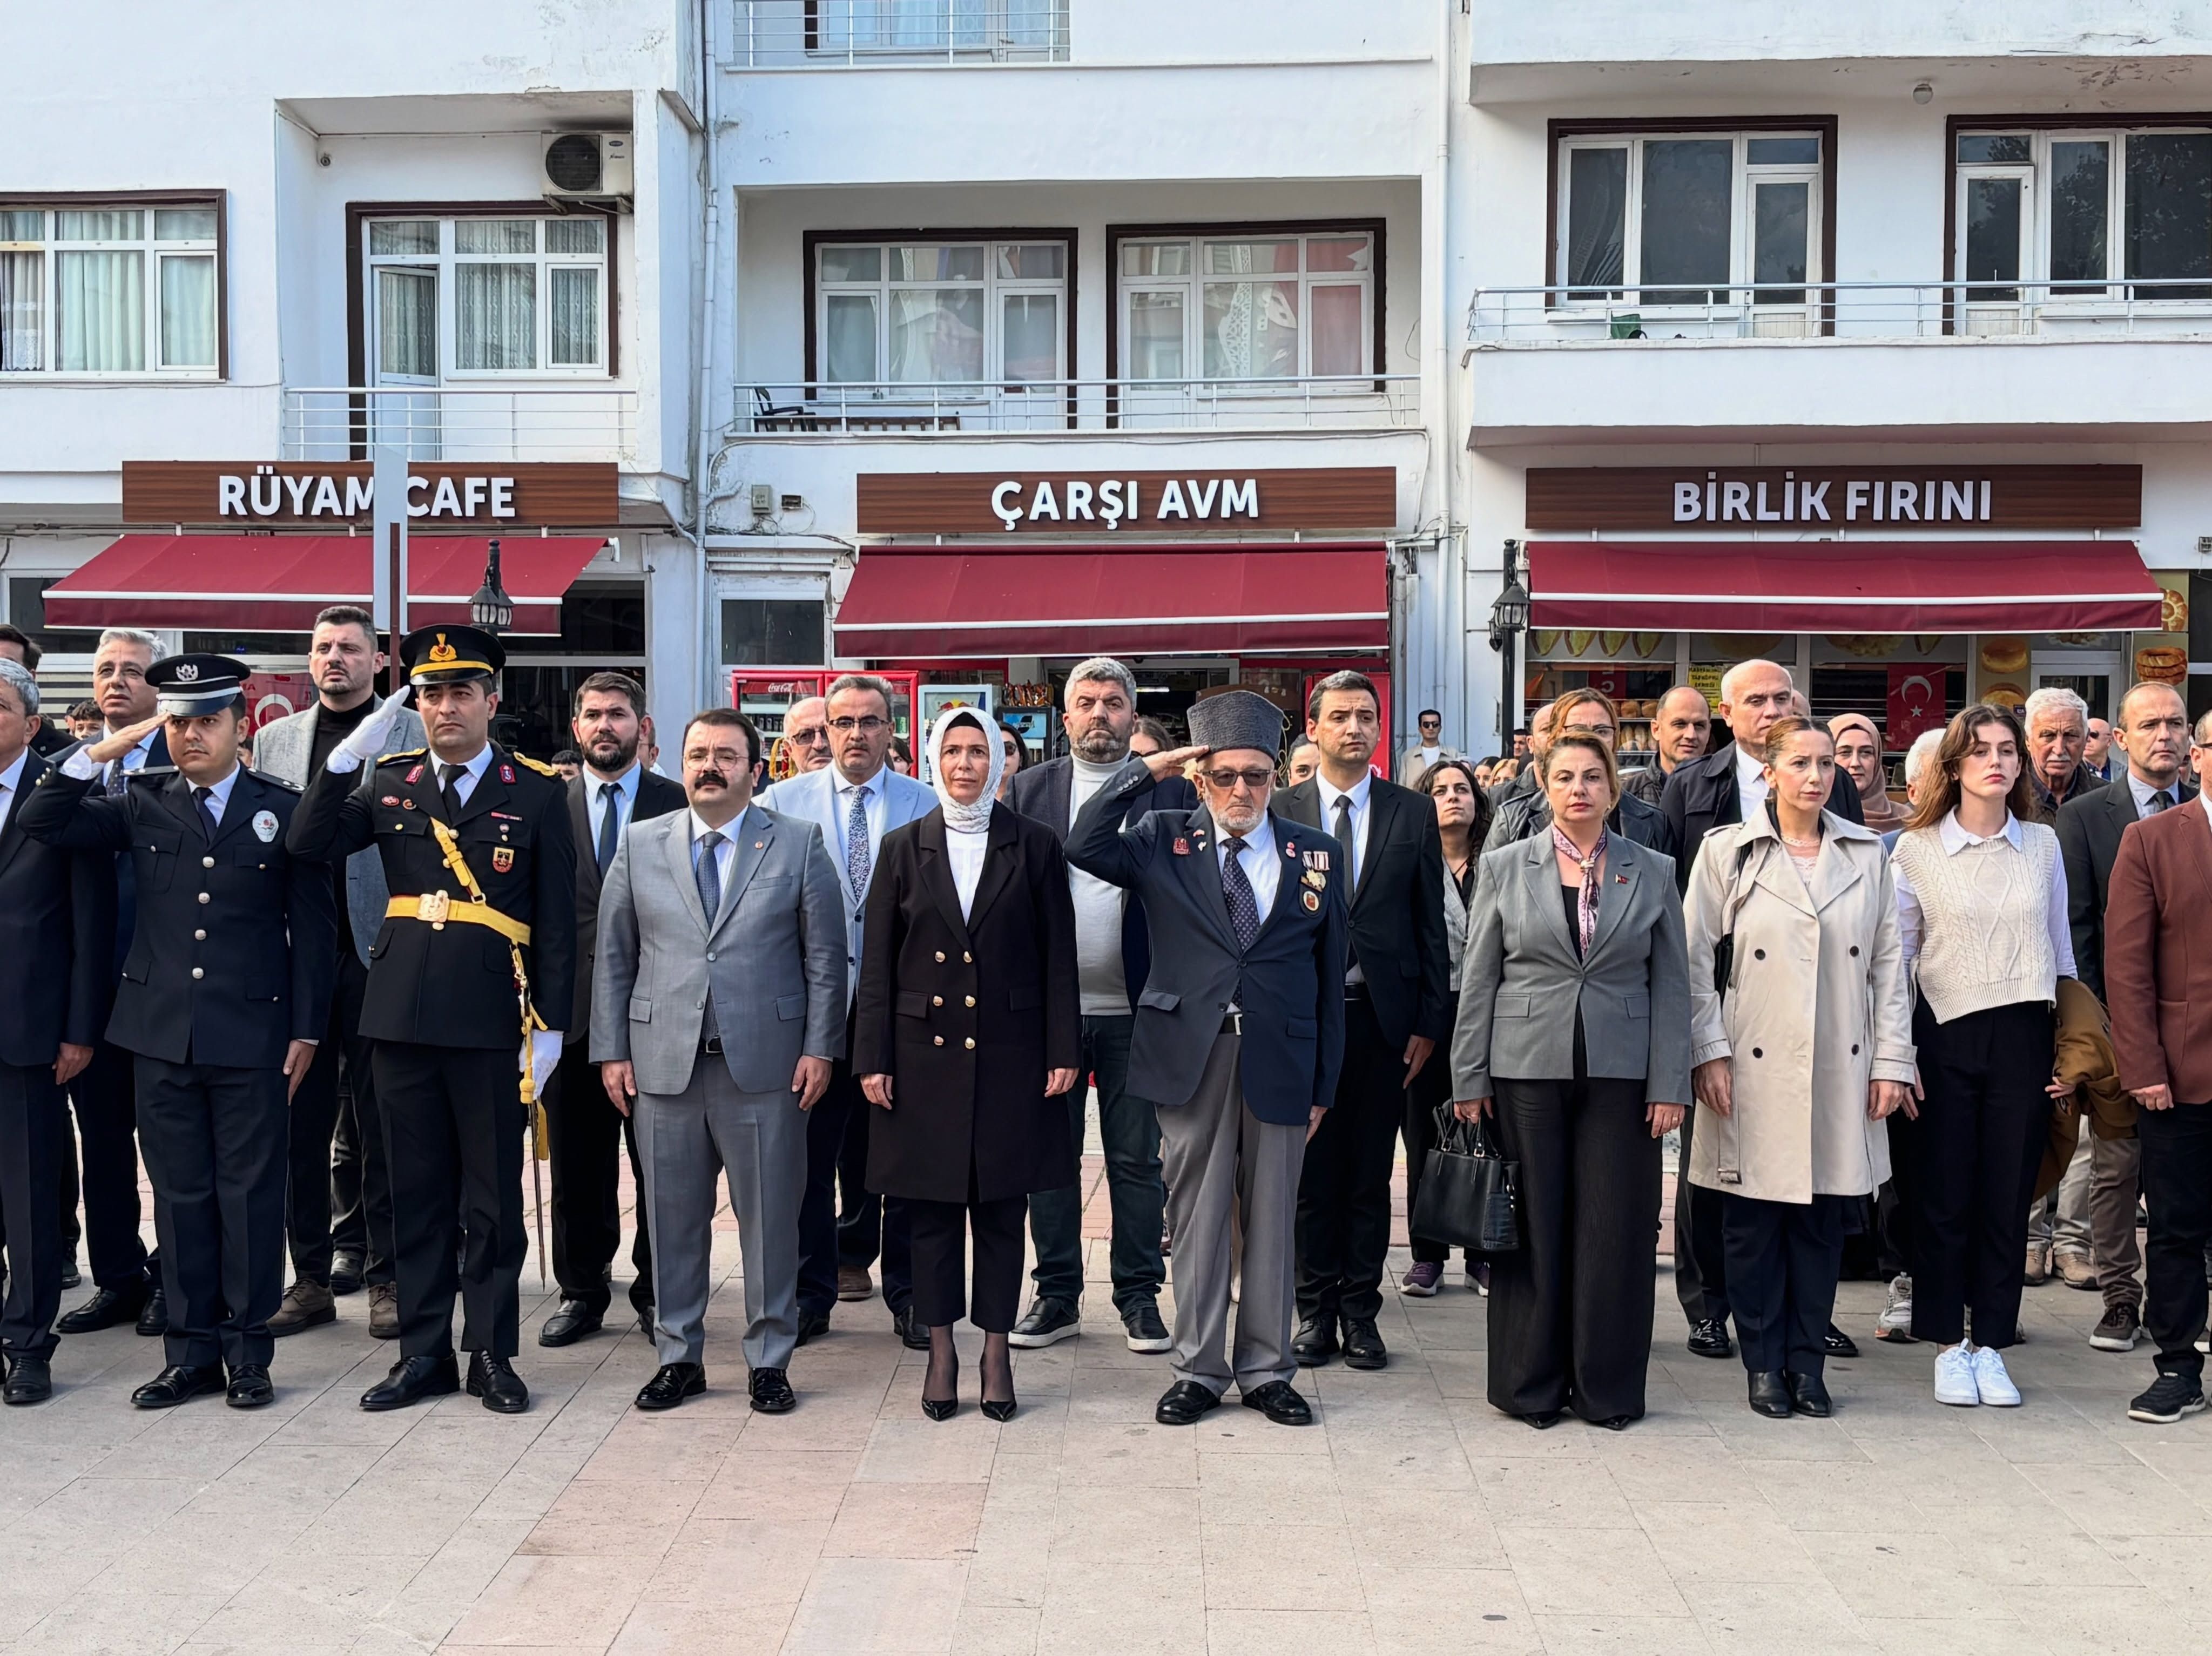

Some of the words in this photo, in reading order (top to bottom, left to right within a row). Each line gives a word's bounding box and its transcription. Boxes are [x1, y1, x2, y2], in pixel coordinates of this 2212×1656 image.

[219, 465, 374, 516] RÜYAM
[407, 476, 515, 517] CAFE
[992, 480, 1137, 531] ÇARŞI
[1157, 479, 1258, 518] AVM
[1674, 471, 1831, 522] BİRLİK
[1846, 481, 1991, 521] FIRINI
